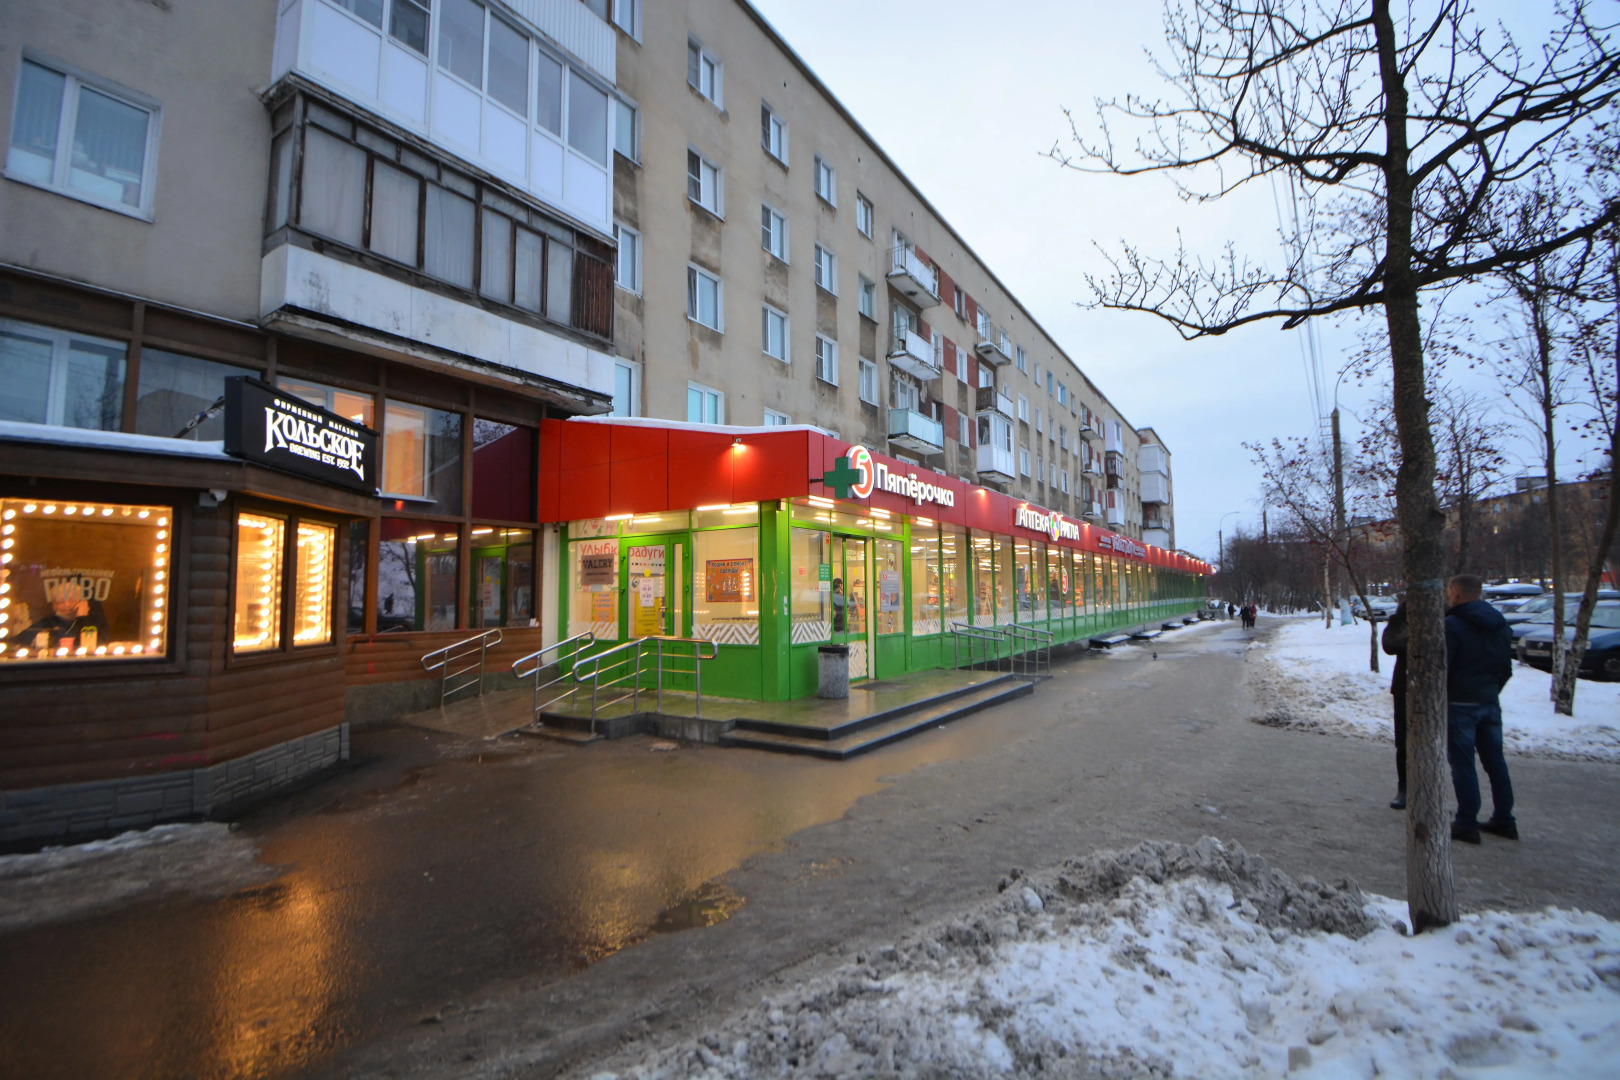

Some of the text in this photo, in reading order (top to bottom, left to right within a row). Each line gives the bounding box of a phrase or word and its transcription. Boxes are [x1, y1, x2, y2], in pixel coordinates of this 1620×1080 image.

[274, 398, 359, 438] ФИРМЕННЫЙ МАГАЗИН
[264, 407, 365, 481] КОЛЬСКОЕ
[875, 463, 954, 506] Пятёрочка
[1016, 508, 1050, 533] АПТЕКА
[43, 577, 112, 603] ПИВО
